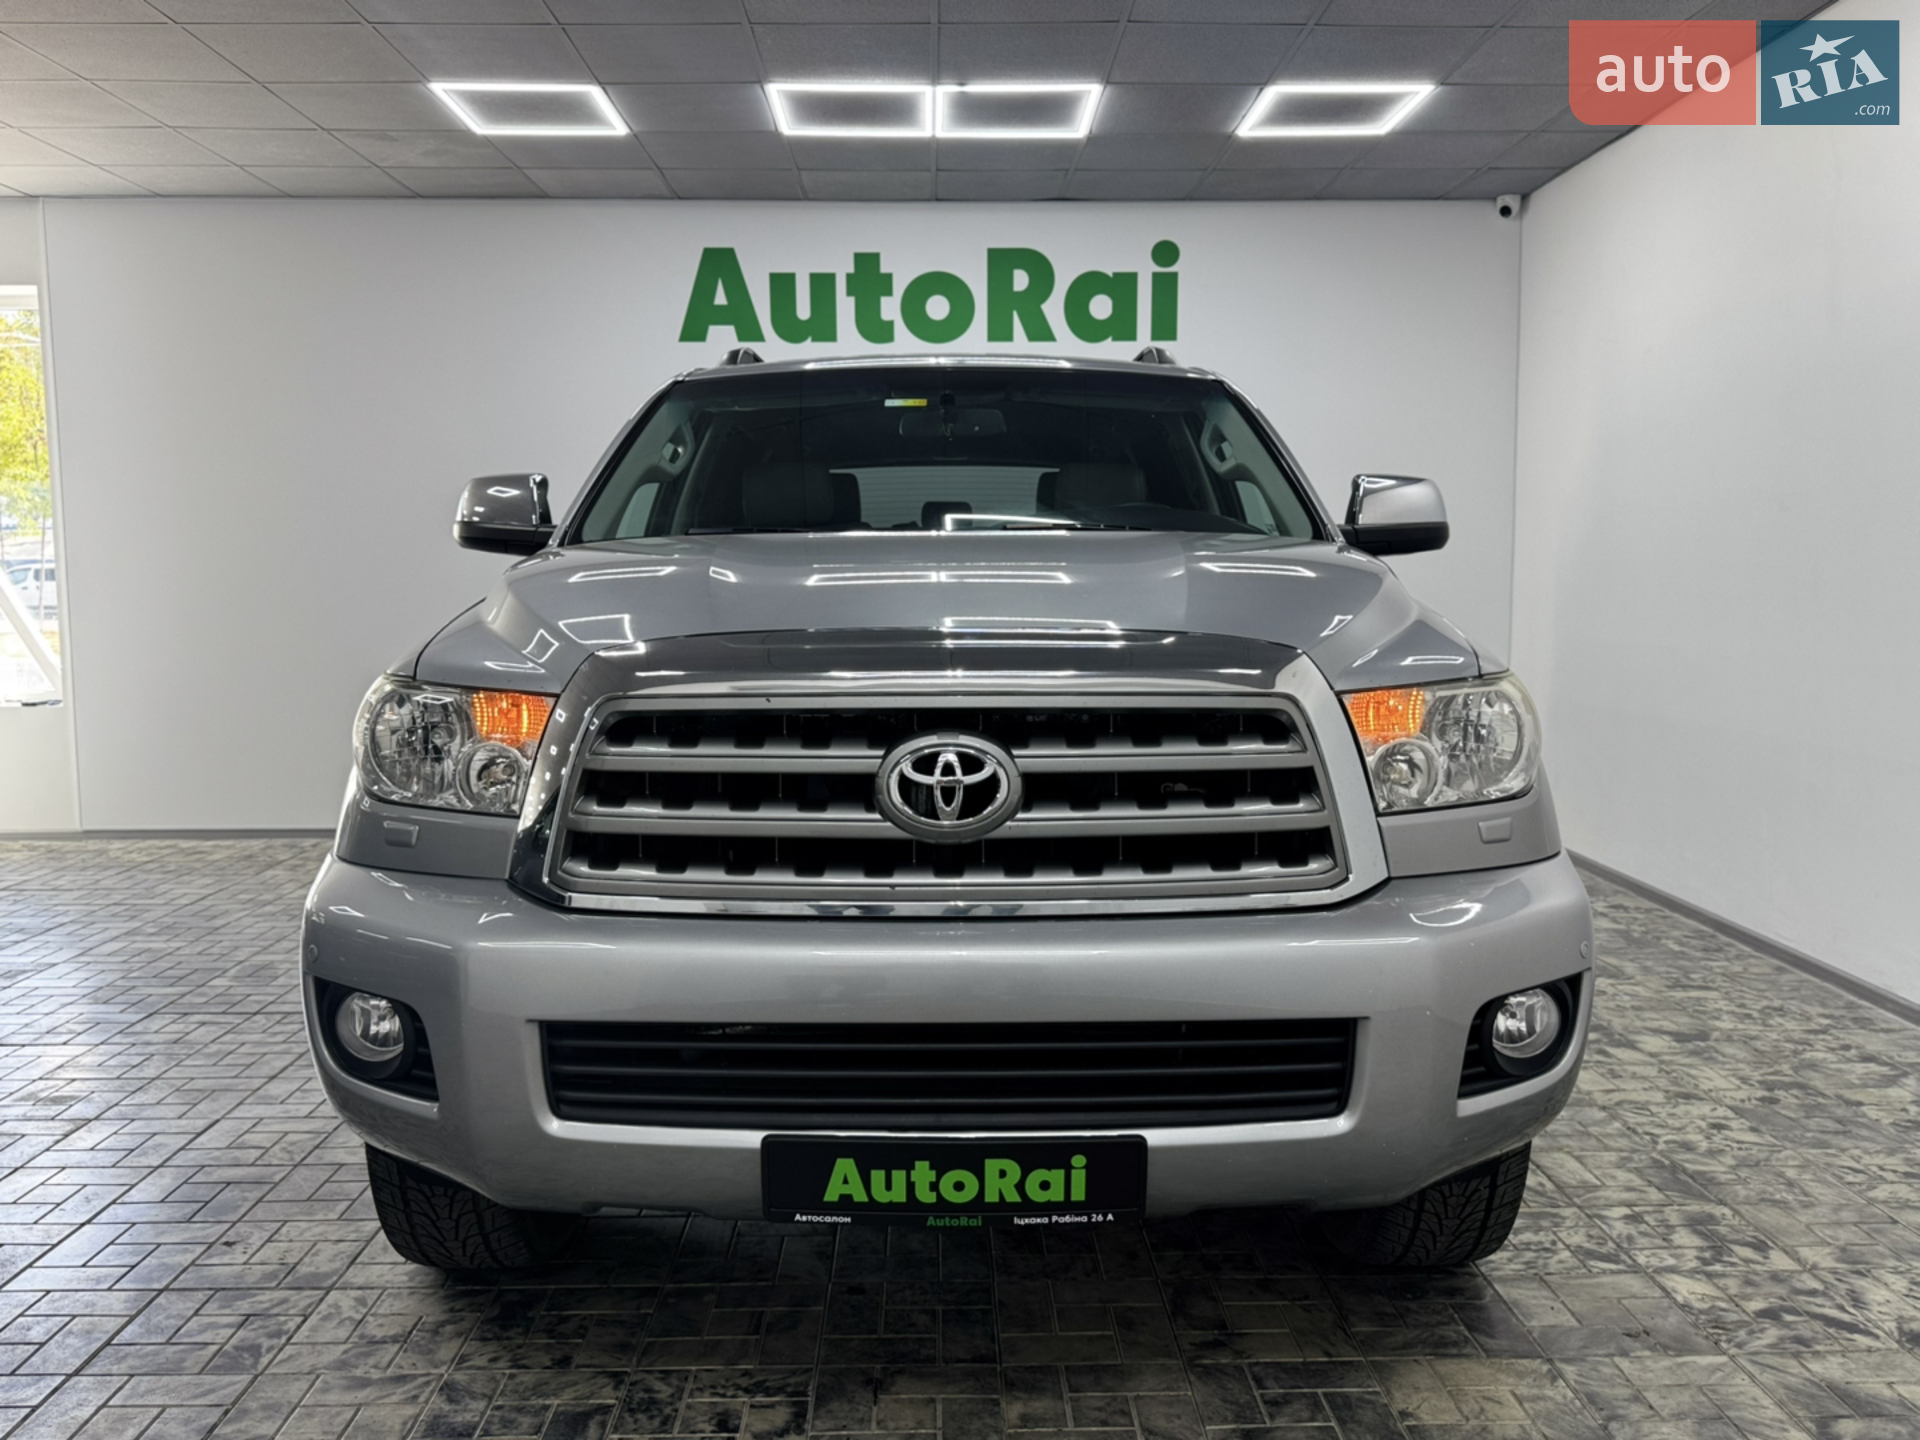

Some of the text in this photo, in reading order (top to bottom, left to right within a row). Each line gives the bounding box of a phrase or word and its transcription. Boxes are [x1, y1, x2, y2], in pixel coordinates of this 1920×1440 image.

[678, 239, 1181, 344] AutoRai
[823, 1154, 1087, 1204] AutoRai
[794, 1213, 852, 1224] Автосалон
[926, 1215, 982, 1227] AutoRai
[1051, 1214, 1088, 1224] Рабіна
[1090, 1213, 1104, 1222] 26
